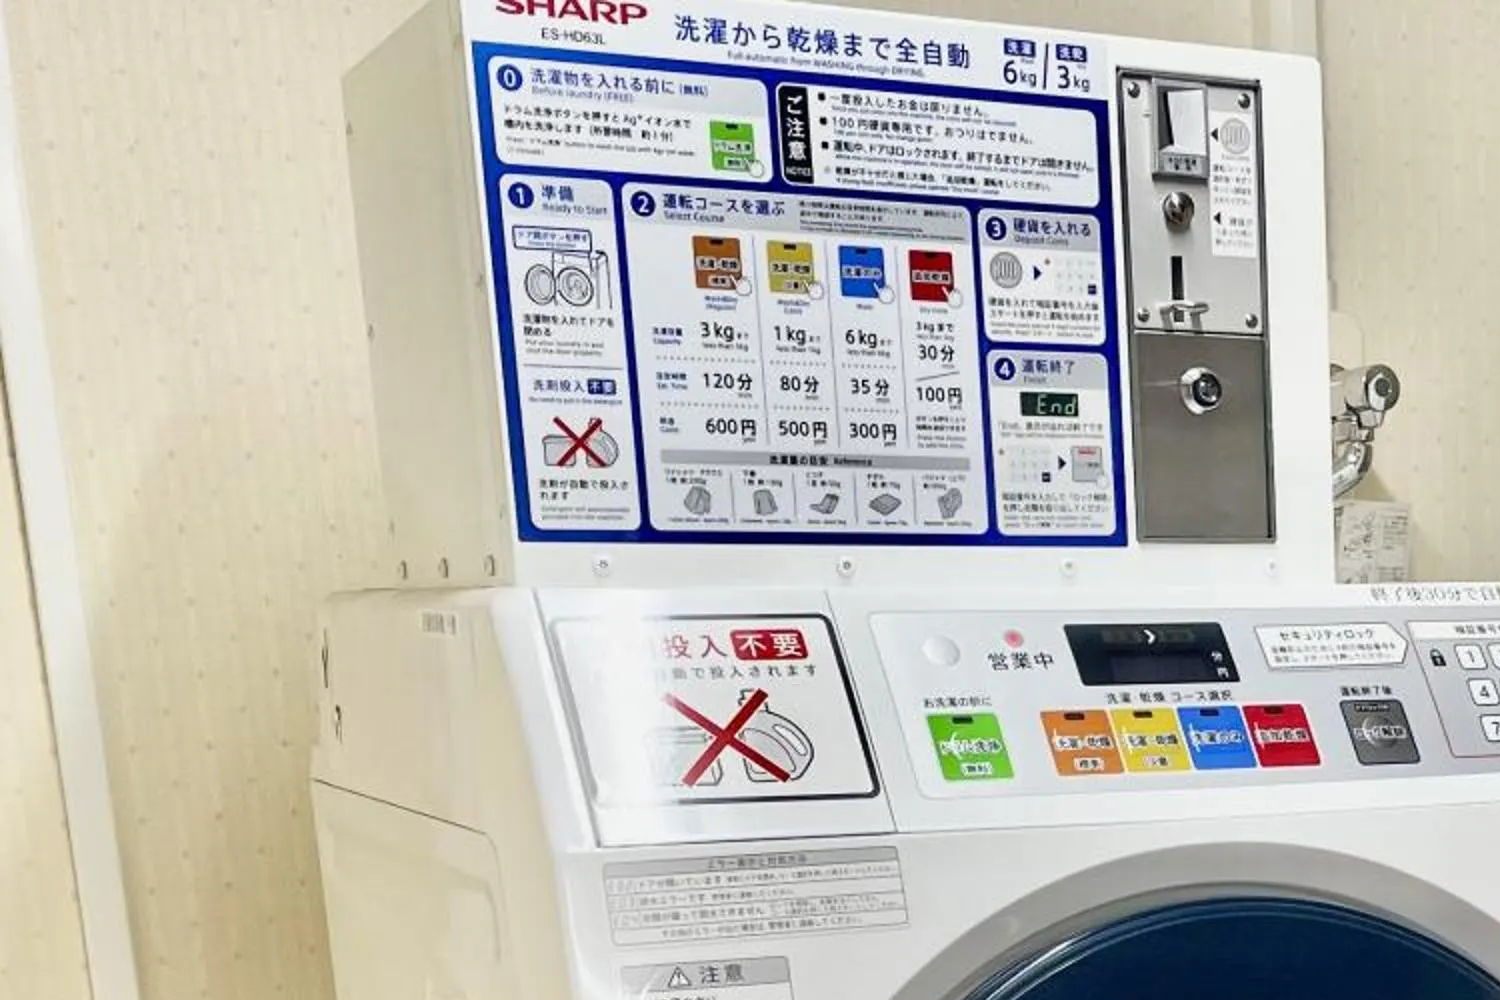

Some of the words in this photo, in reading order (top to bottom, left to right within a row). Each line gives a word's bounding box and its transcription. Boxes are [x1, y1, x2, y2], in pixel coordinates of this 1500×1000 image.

[496, 0, 648, 25] SHARP
[541, 27, 606, 45] ES-HD63L
[675, 14, 970, 69] 洗濯から乾燥まで全自動
[531, 67, 675, 94] 洗濯物を入れる前に
[541, 185, 574, 202] 準備
[542, 202, 572, 215] Ready
[574, 205, 584, 213] to
[586, 206, 607, 216] Start
[636, 195, 650, 213] 2
[663, 193, 785, 216] 運転コースを選ぶ
[664, 210, 690, 221] Select
[990, 220, 1003, 237] 3
[1013, 217, 1092, 237] 硬貨を入れる
[701, 321, 734, 342] 3kg
[774, 325, 806, 346] 1kg
[845, 329, 877, 349] 6kg
[918, 345, 955, 362] 30分
[998, 363, 1011, 378] 4
[1022, 359, 1075, 376] 運転終了
[533, 380, 585, 393] 洗剤投入
[703, 373, 752, 391] 120分
[780, 376, 819, 393] 80分
[851, 378, 889, 396] 35分
[916, 387, 962, 404] 100円
[1037, 394, 1077, 415] End
[705, 419, 757, 437] 600円
[778, 421, 828, 440] 500円
[849, 422, 897, 440] 300円
[735, 633, 803, 657] 不要
[1279, 629, 1374, 641] セキュリティロック
[987, 652, 1054, 672] 営業中
[1466, 649, 1475, 665] 1
[1478, 685, 1490, 698] 4
[1491, 721, 1500, 735] 7
[700, 964, 745, 984] 注意
